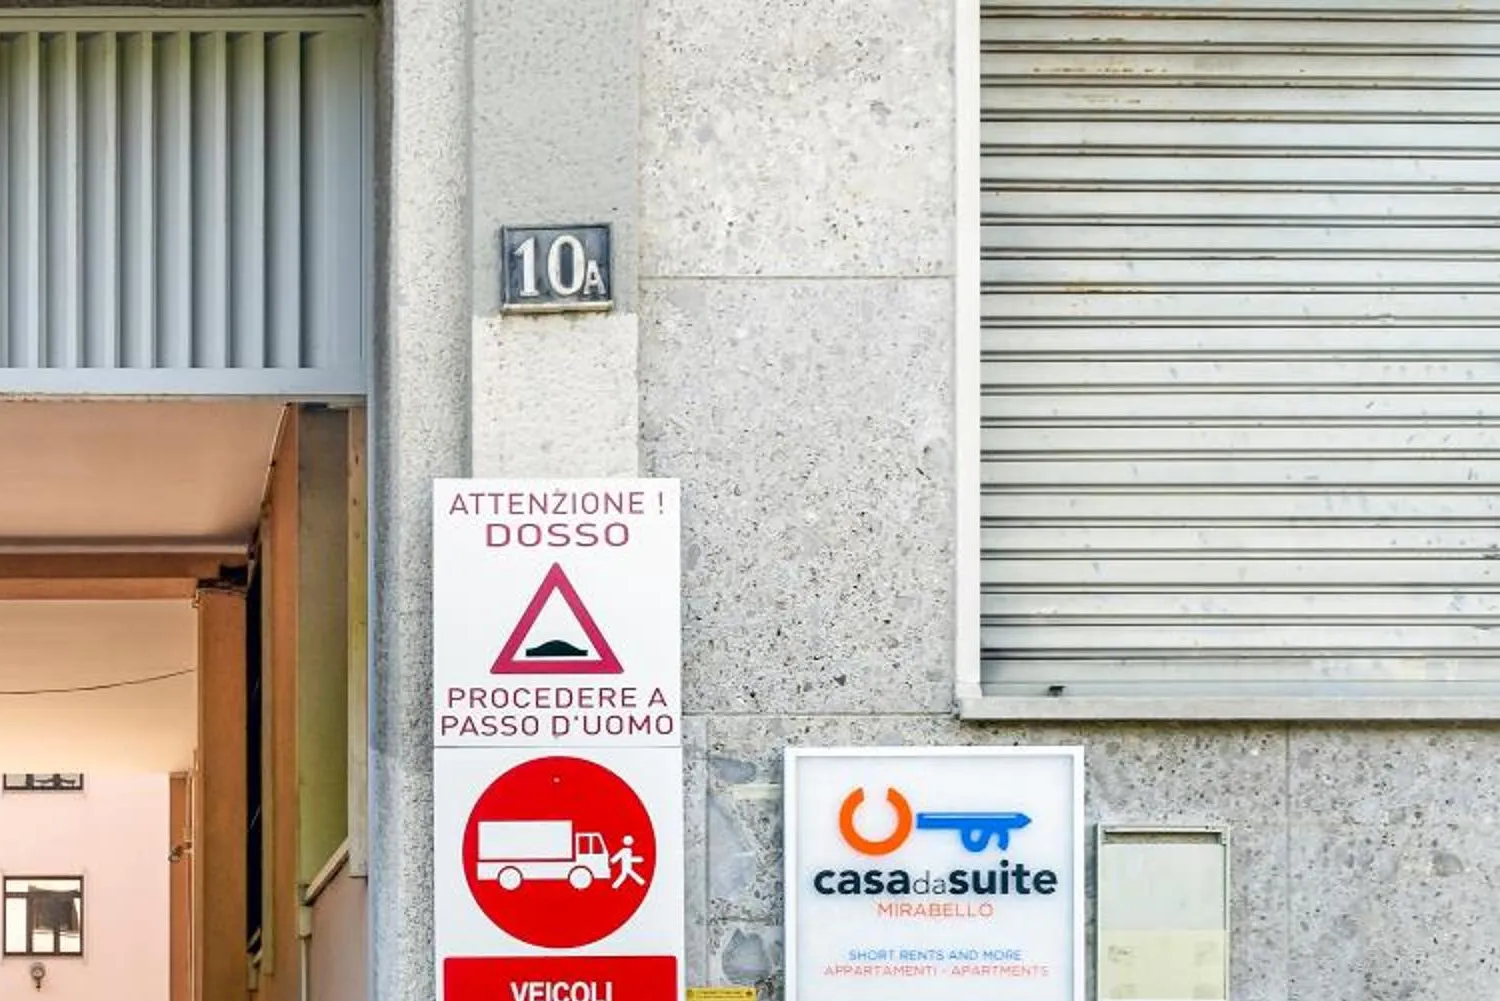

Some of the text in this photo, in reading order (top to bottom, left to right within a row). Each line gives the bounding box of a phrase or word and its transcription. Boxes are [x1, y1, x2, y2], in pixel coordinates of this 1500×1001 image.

[513, 235, 606, 296] 10A
[449, 492, 645, 514] ATTENZIONE
[485, 523, 630, 547] DOSSO
[448, 687, 668, 708] PROCEDERE A
[440, 714, 674, 736] PASSO D'UOMO
[876, 902, 994, 918] MIRABELLO
[848, 949, 1023, 961] SHORT RENTS AND MORE
[823, 965, 937, 976] APPARTAMENTI
[951, 965, 1049, 976] APARTMENTS
